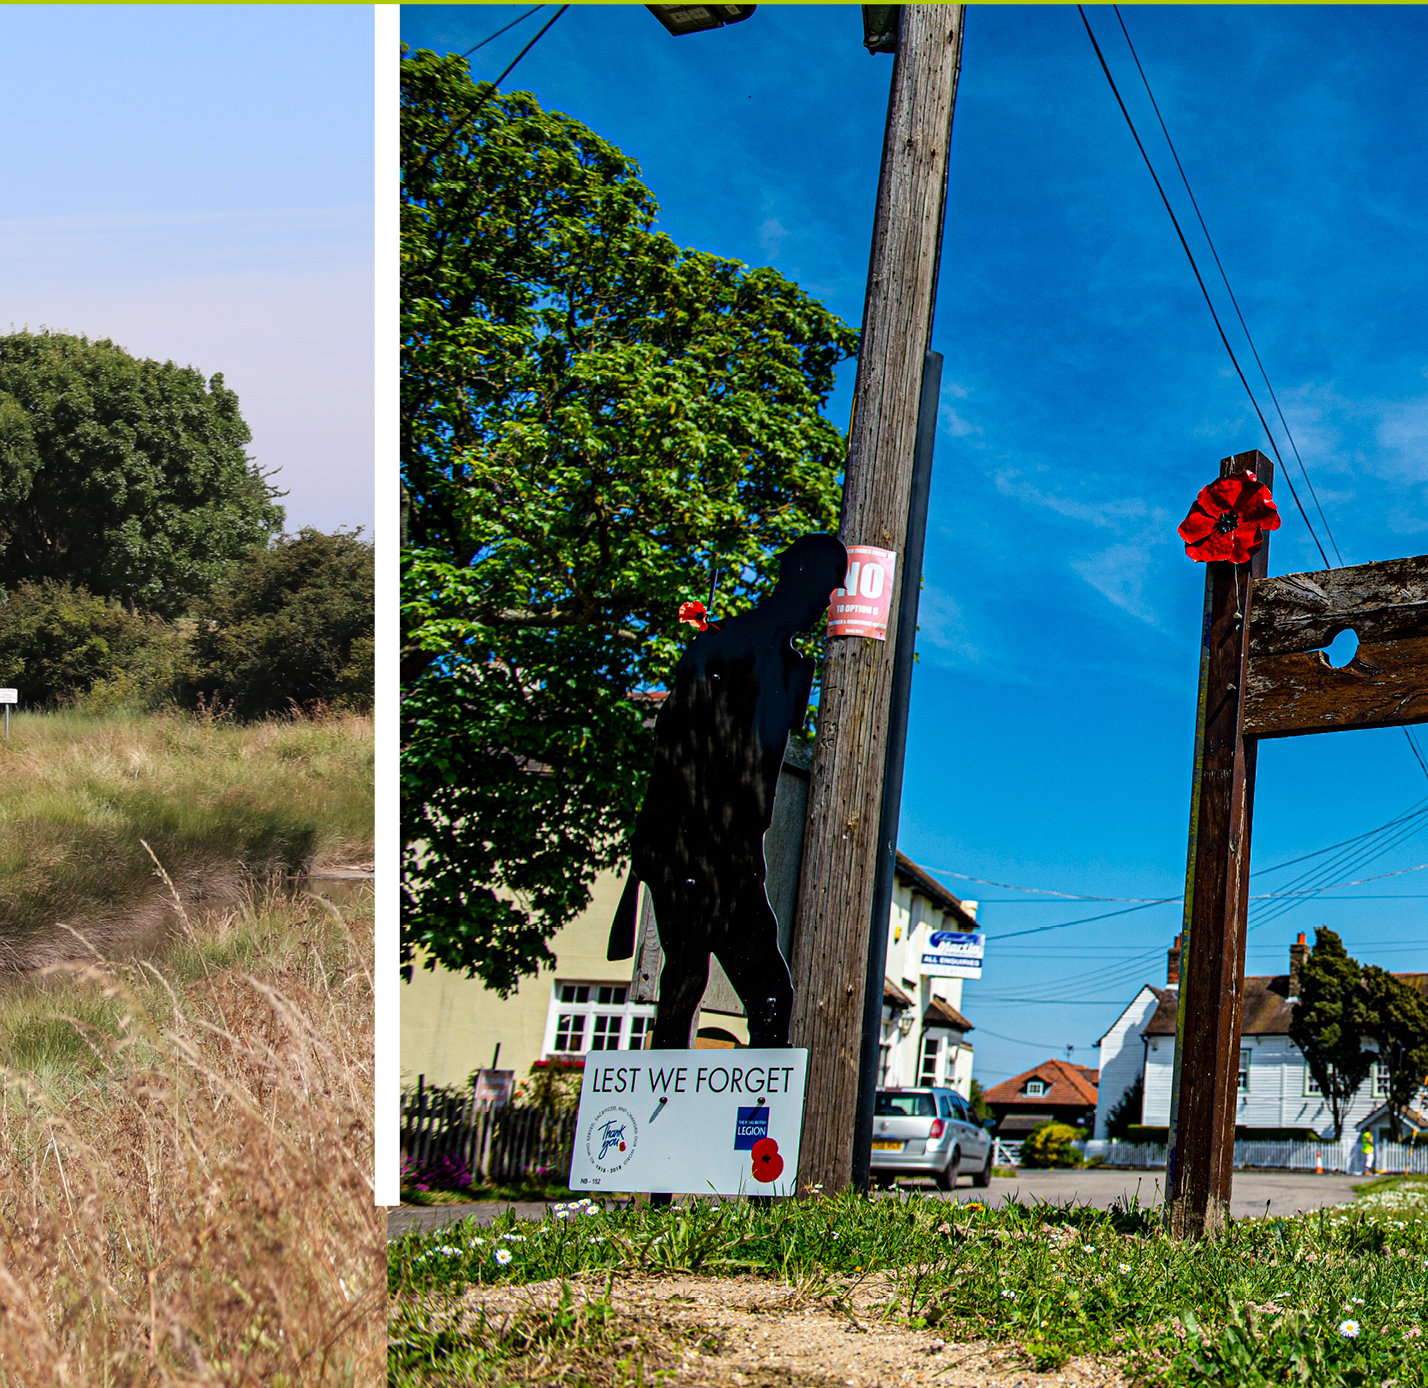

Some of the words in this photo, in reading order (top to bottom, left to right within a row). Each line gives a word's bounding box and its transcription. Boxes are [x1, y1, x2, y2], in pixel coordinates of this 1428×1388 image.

[837, 561, 885, 599] NO
[837, 605, 844, 613] TO
[845, 604, 872, 614] OPTION
[923, 955, 937, 963] ALL
[939, 957, 980, 967] ENQUIRIES
[592, 1067, 641, 1093] LEST
[648, 1067, 688, 1093] WE
[695, 1067, 794, 1093] FORGET
[597, 1119, 626, 1140] Thank
[737, 1126, 766, 1135] LEGION
[598, 1138, 620, 1160] you
